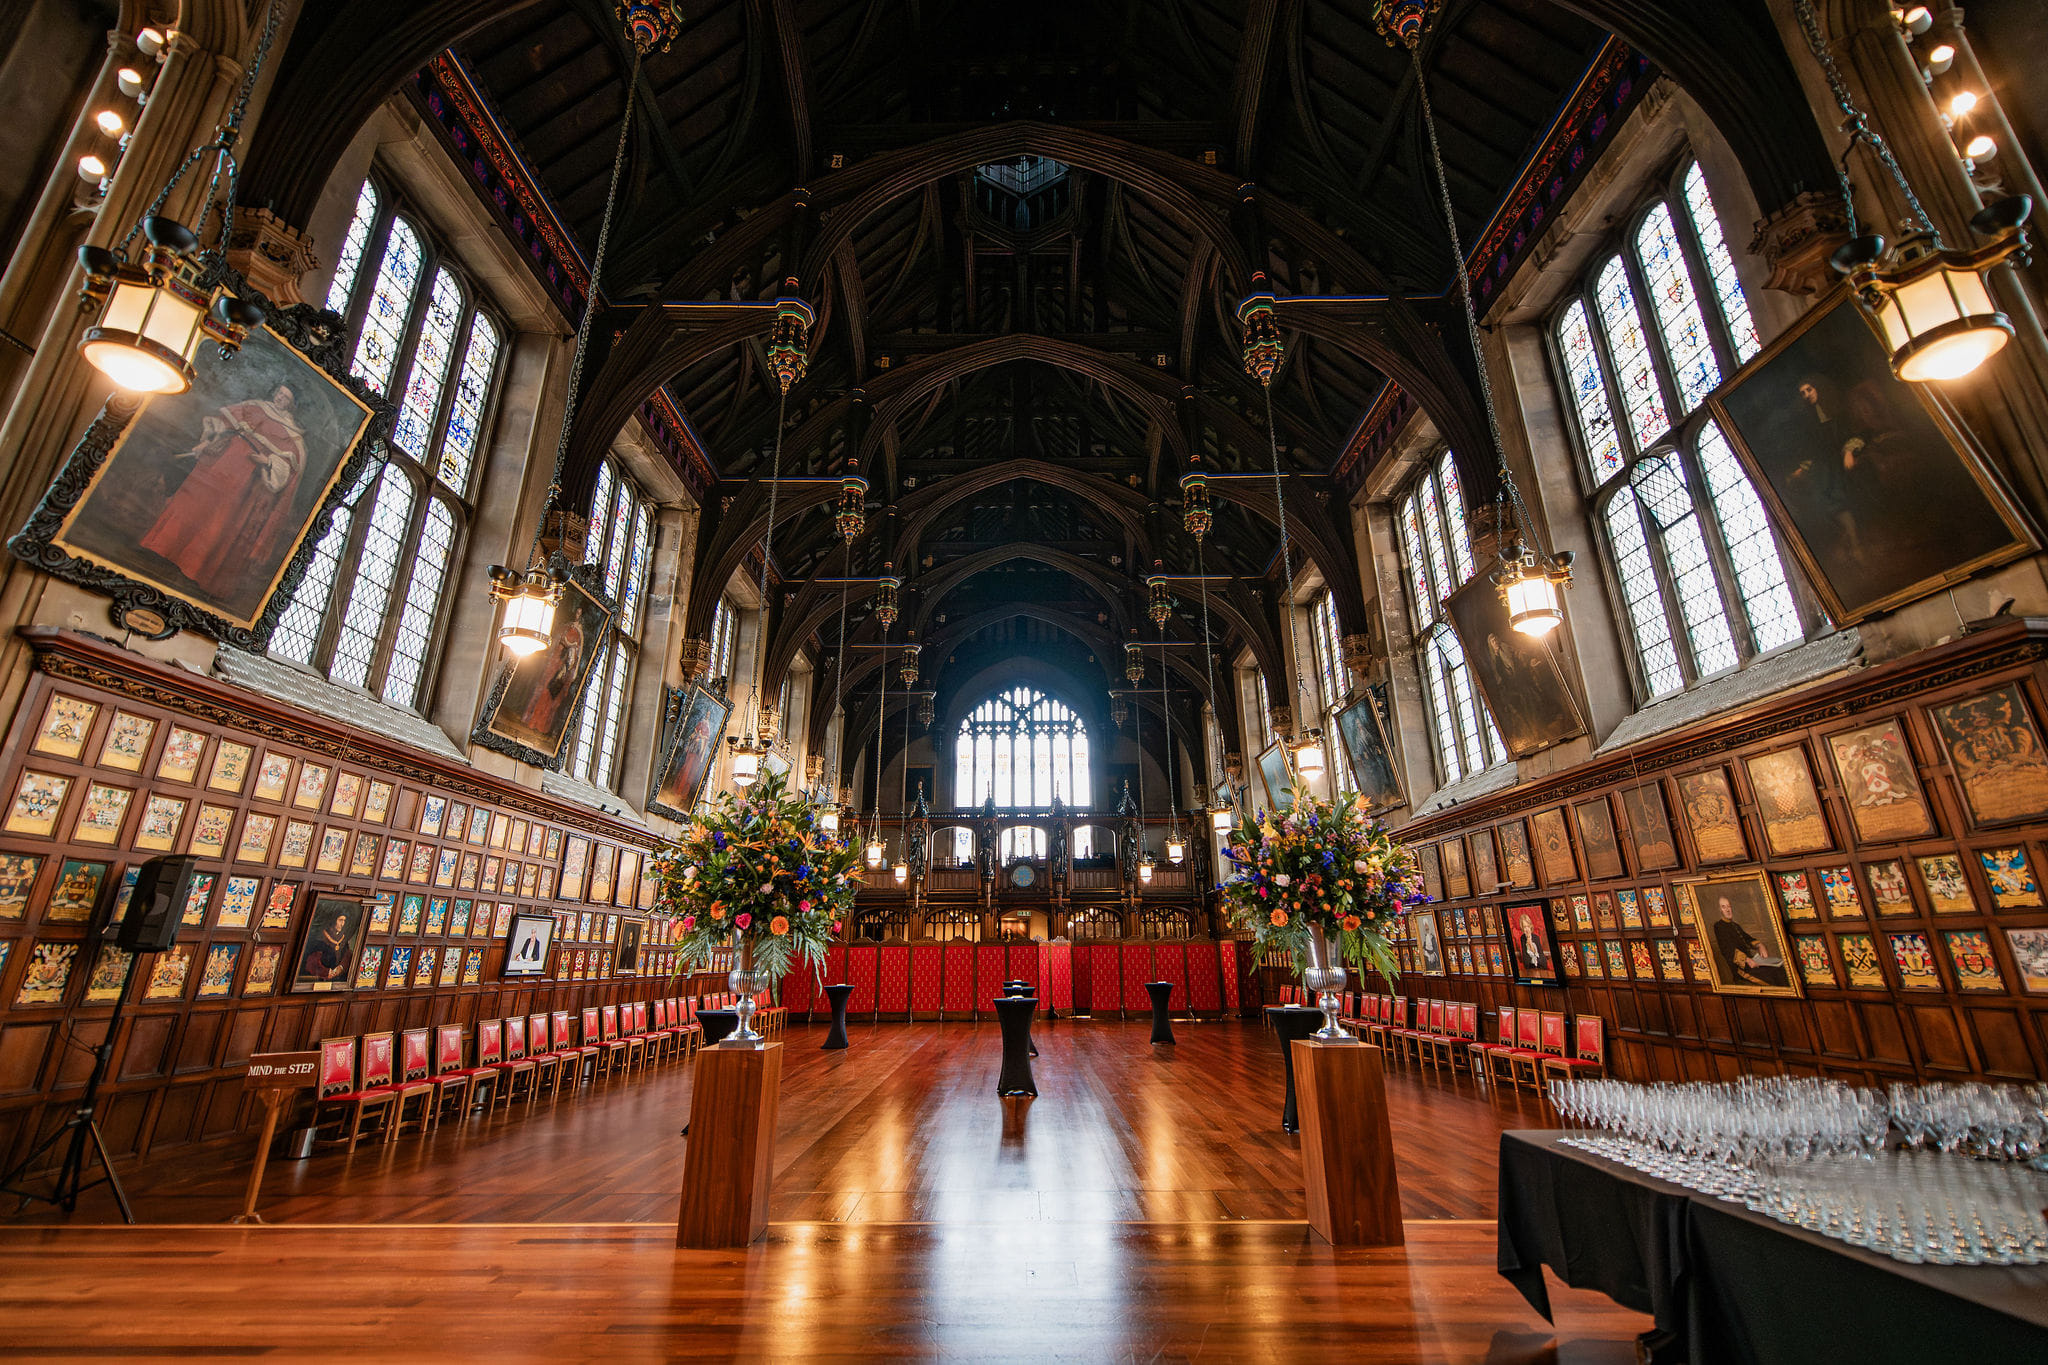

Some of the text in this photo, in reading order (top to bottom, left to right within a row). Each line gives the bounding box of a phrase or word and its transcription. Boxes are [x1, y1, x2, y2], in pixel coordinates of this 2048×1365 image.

[247, 1063, 315, 1076] MIND THE STEP
